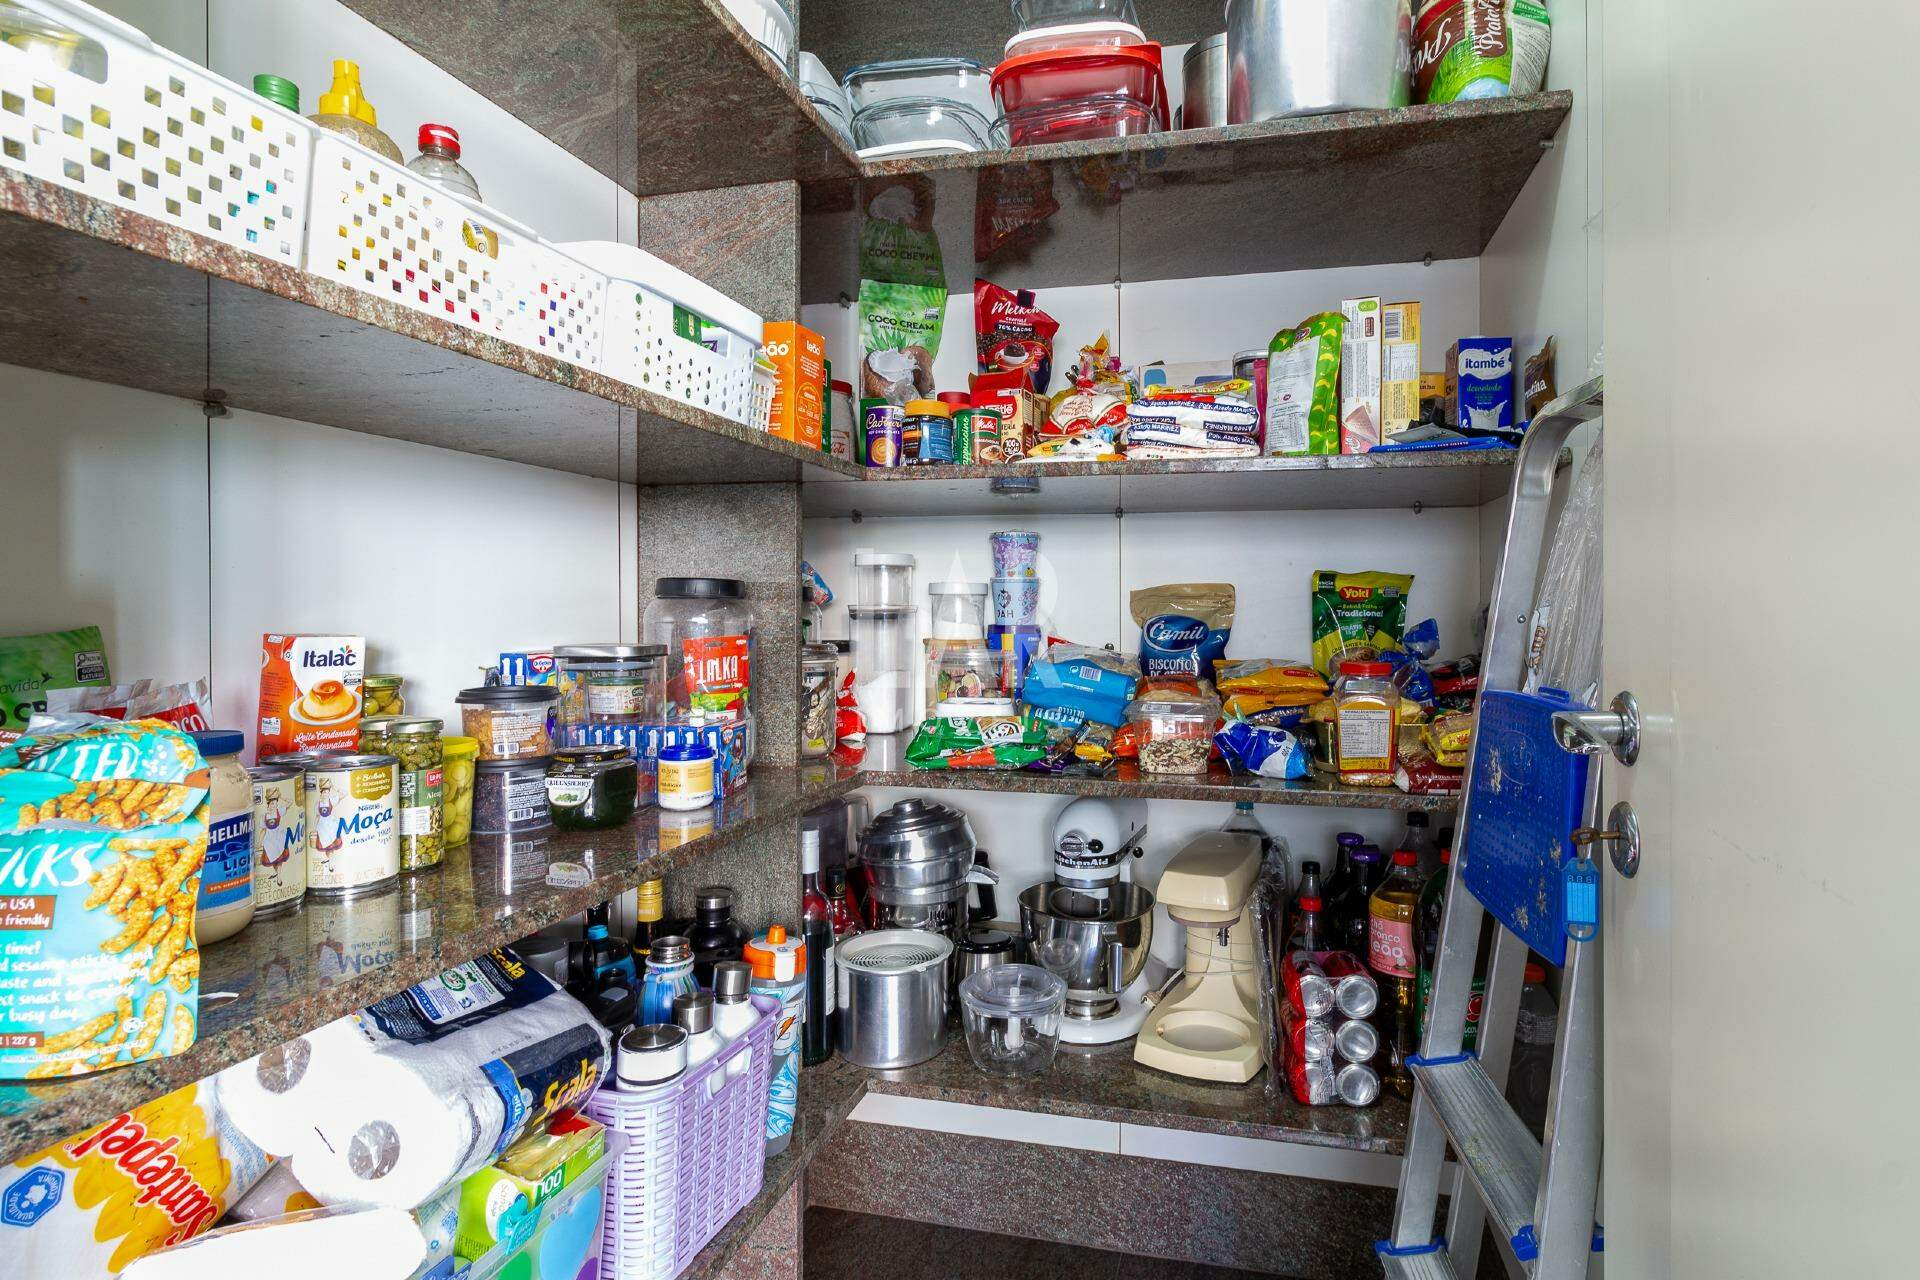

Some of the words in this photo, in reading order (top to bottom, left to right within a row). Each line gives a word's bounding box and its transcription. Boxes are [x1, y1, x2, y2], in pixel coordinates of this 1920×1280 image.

[868, 314, 897, 326] COCO
[900, 320, 934, 331] CREAM
[1465, 357, 1505, 369] itambé
[1344, 588, 1368, 598] Yoki
[1149, 621, 1203, 640] Camil
[303, 650, 357, 668] Italac
[336, 807, 393, 838] Moça
[0, 842, 101, 887] ICKS
[10, 899, 35, 910] USA
[6, 914, 50, 928] friendly
[0, 975, 28, 989] aste
[33, 973, 61, 988] and
[10, 1009, 45, 1024] busy
[12, 1036, 27, 1046] 227
[531, 1058, 597, 1127] Scala
[72, 1112, 217, 1246] Santepel
